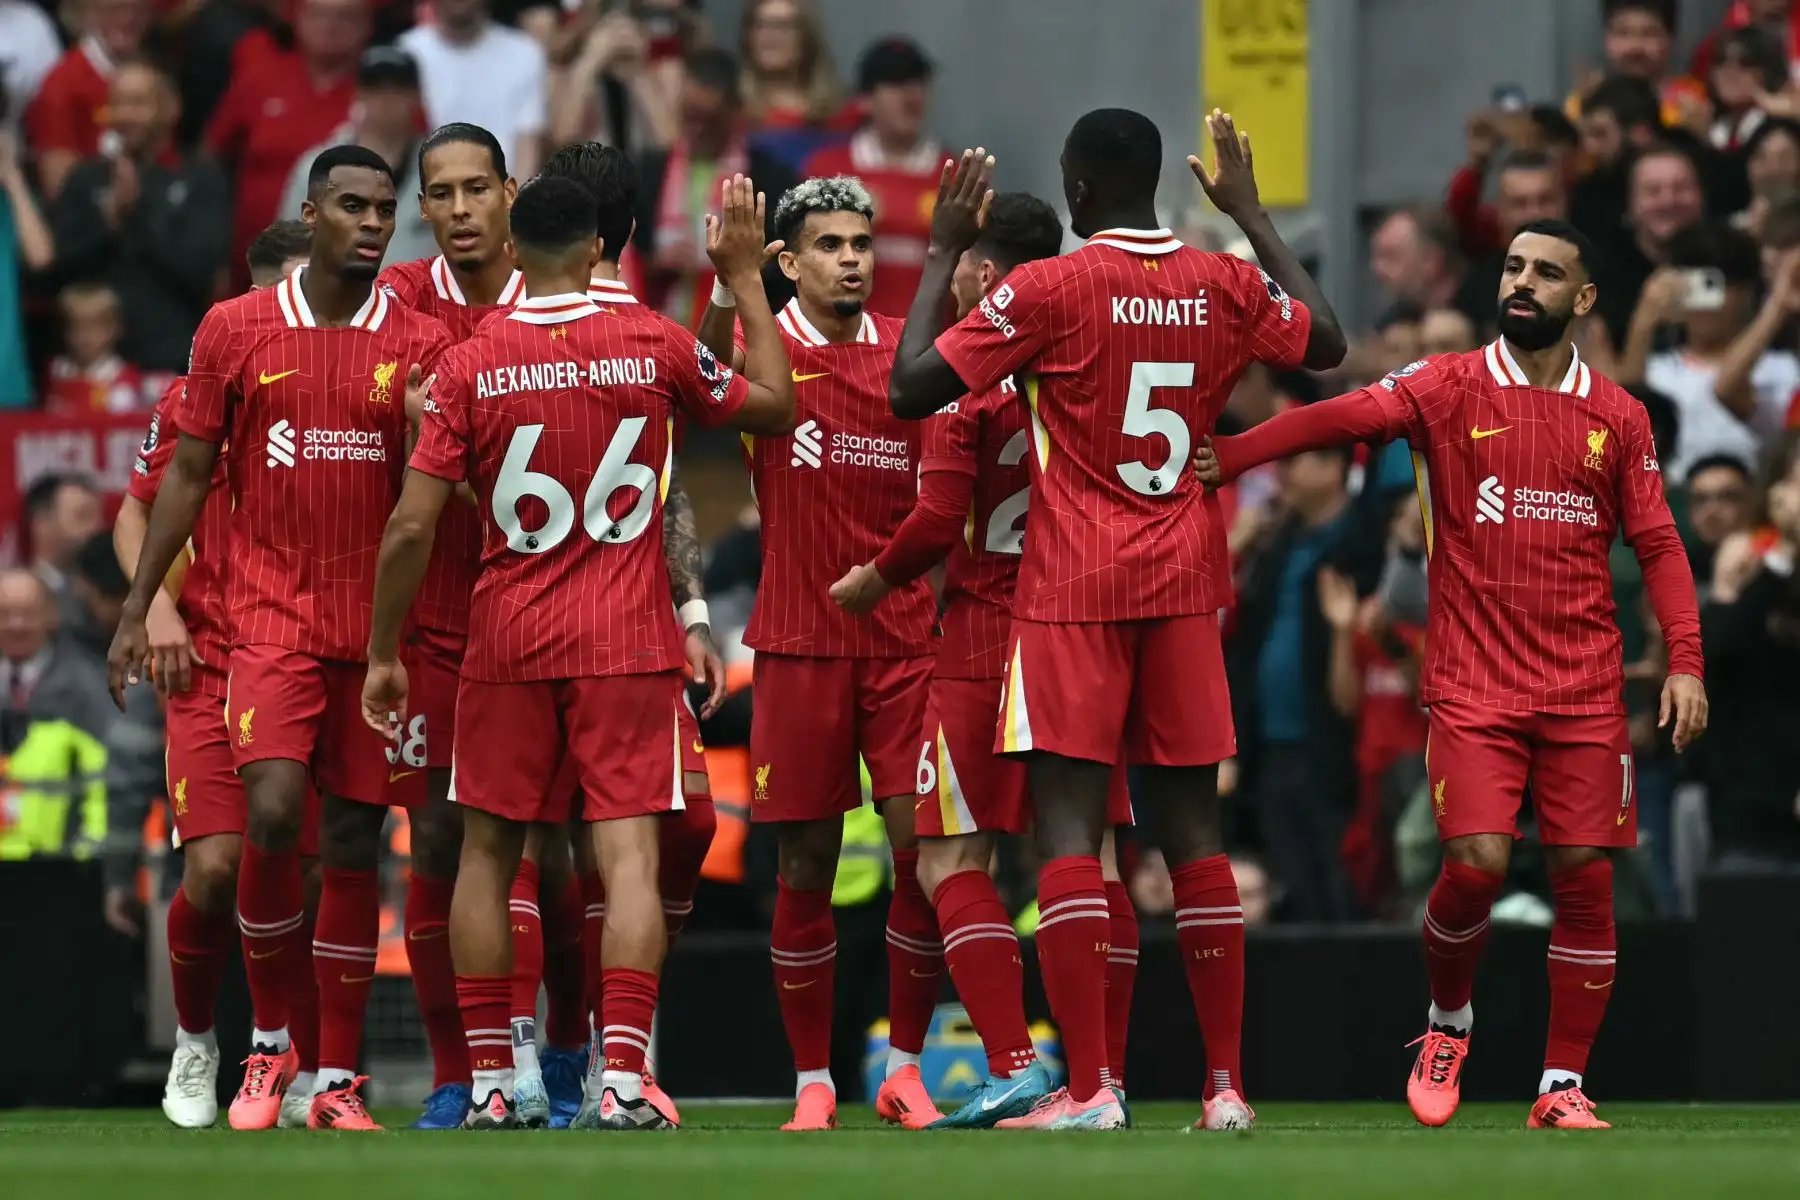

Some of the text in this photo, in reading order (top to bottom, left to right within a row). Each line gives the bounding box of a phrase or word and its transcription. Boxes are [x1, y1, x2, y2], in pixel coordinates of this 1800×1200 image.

[1112, 289, 1208, 326] KONATÉ
[476, 357, 657, 400] ALEXANDER-ARNOLD
[303, 427, 382, 446] standard
[1115, 361, 1195, 496] 5
[303, 444, 386, 462] chartered
[831, 432, 907, 455] standard
[830, 448, 909, 472] chartered
[491, 416, 657, 554] 66
[1513, 486, 1595, 510] standard
[1512, 504, 1598, 527] chartered
[1194, 947, 1225, 960] LFC
[476, 1059, 501, 1068] LFC
